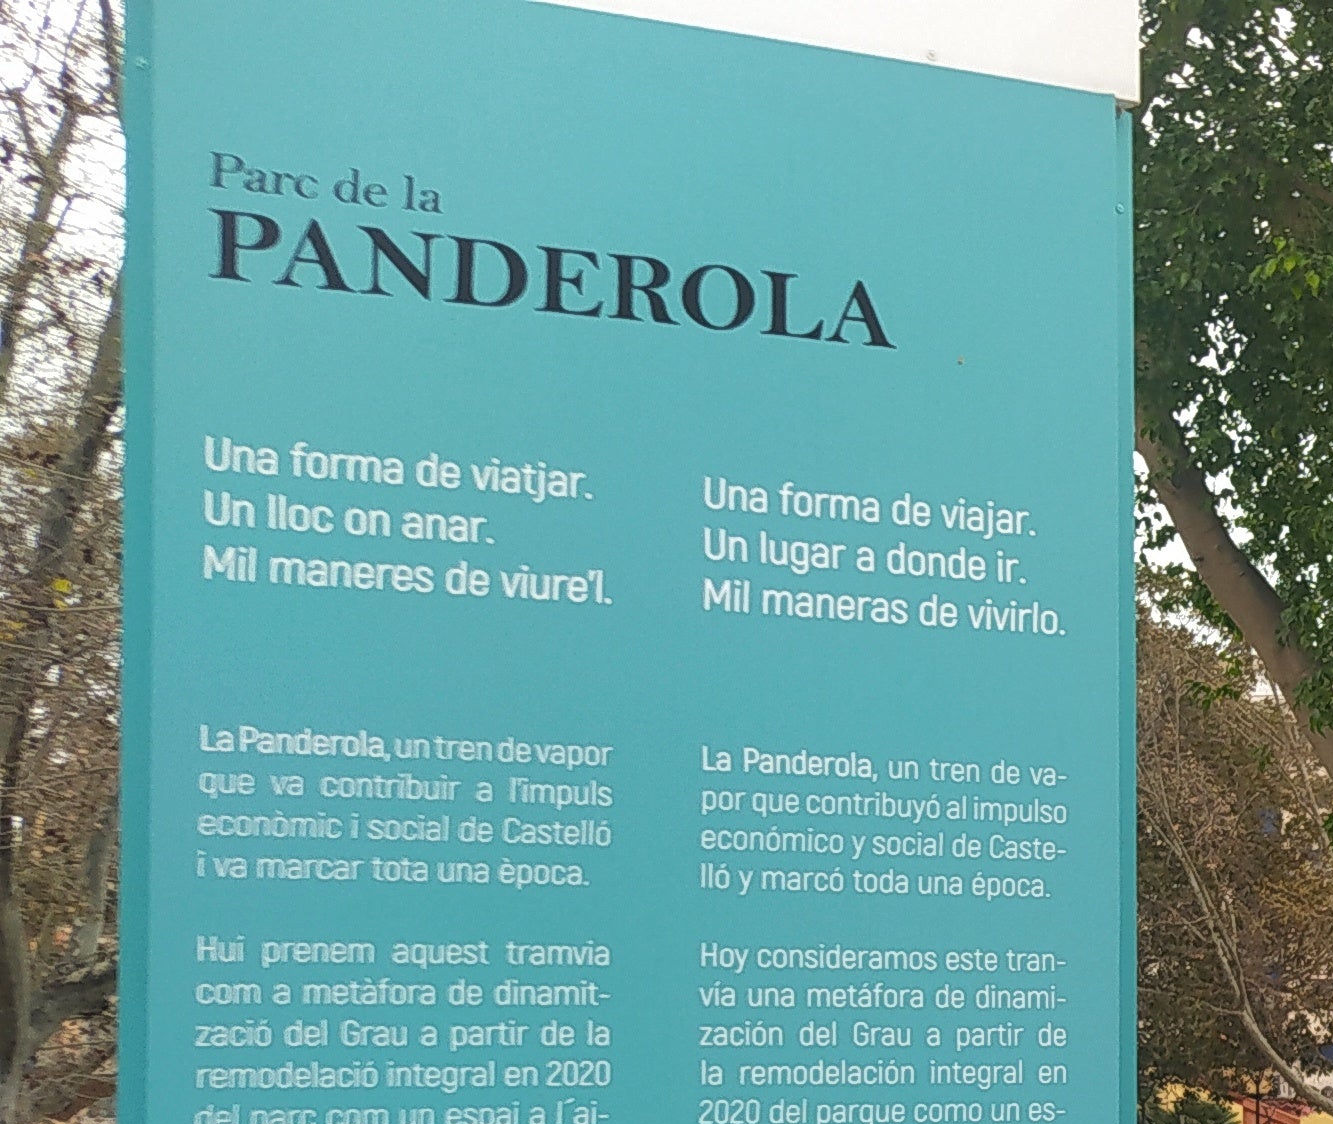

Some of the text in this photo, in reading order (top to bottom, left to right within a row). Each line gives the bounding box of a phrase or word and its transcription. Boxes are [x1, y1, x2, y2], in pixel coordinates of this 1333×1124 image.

[209, 150, 443, 214] Parc de la
[209, 208, 897, 350] PANDEROLA
[204, 435, 593, 504] Una forma de viatjar.
[204, 489, 495, 545] Un lloc on anar.
[704, 476, 1036, 540] Una forma de viajar.
[203, 544, 257, 582] Mil
[269, 556, 435, 593] maneres
[445, 560, 490, 597] de
[703, 527, 1027, 584] Un lugar a donde ir.
[703, 578, 1066, 636] Mil maneras de vivirlo.
[702, 745, 1068, 787] La Panderola, un tren de va-
[701, 790, 1067, 827] por que contribuyó al impulso
[700, 825, 1067, 861] económico y social de Caste-
[700, 862, 1051, 902] lló y marcó toda una época.
[700, 942, 1067, 974] Hoy consideramos este tran-
[699, 980, 1067, 1010] vía una metáfora de dinami-
[699, 1020, 1067, 1052] zación del Grau a partir de
[701, 1059, 1067, 1090] la remodelación integral en
[698, 1098, 761, 1124] 2020
[768, 1098, 808, 1124] del
[913, 1102, 983, 1123] como
[991, 1102, 1020, 1122] un
[1028, 1102, 1066, 1122] es-
